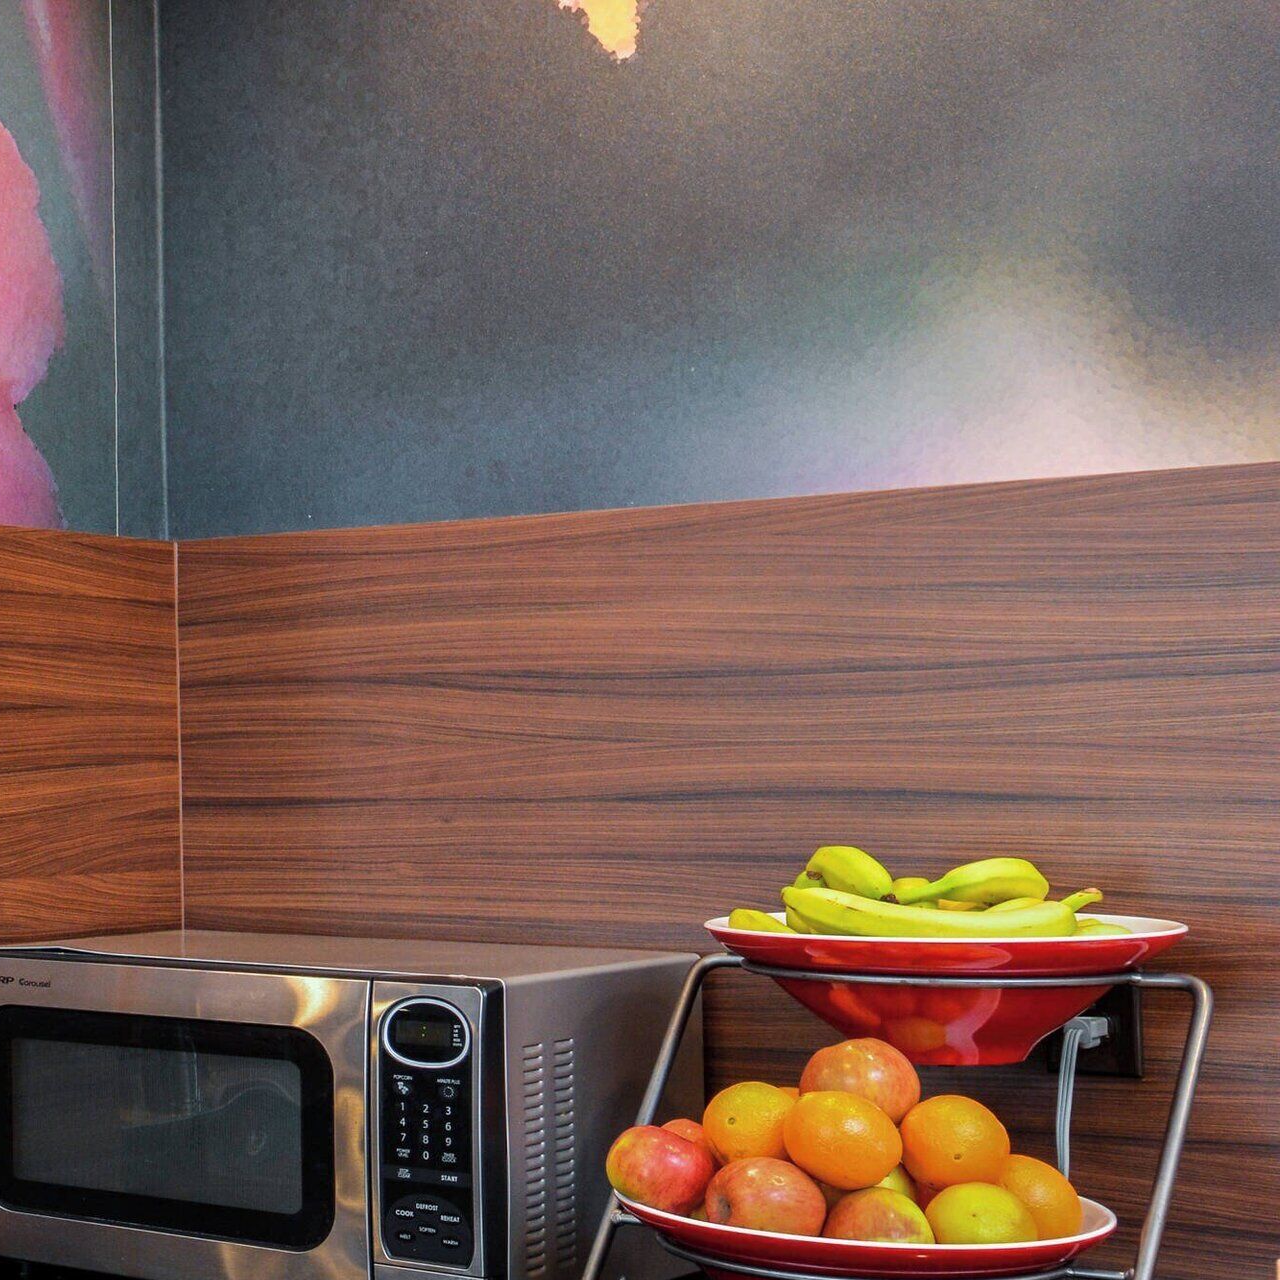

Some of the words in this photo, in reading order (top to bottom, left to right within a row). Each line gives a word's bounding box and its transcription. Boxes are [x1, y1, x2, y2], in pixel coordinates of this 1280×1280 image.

[422, 1103, 429, 1114] 2
[445, 1106, 452, 1116] 3
[422, 1119, 429, 1129] 5
[445, 1122, 452, 1131] 6
[422, 1135, 429, 1144] 8
[445, 1137, 452, 1146] 9
[422, 1151, 430, 1160] 0
[441, 1174, 458, 1182] START
[415, 1203, 439, 1211] DEFROST
[395, 1209, 415, 1217] COOK
[440, 1214, 460, 1223] REHEAT
